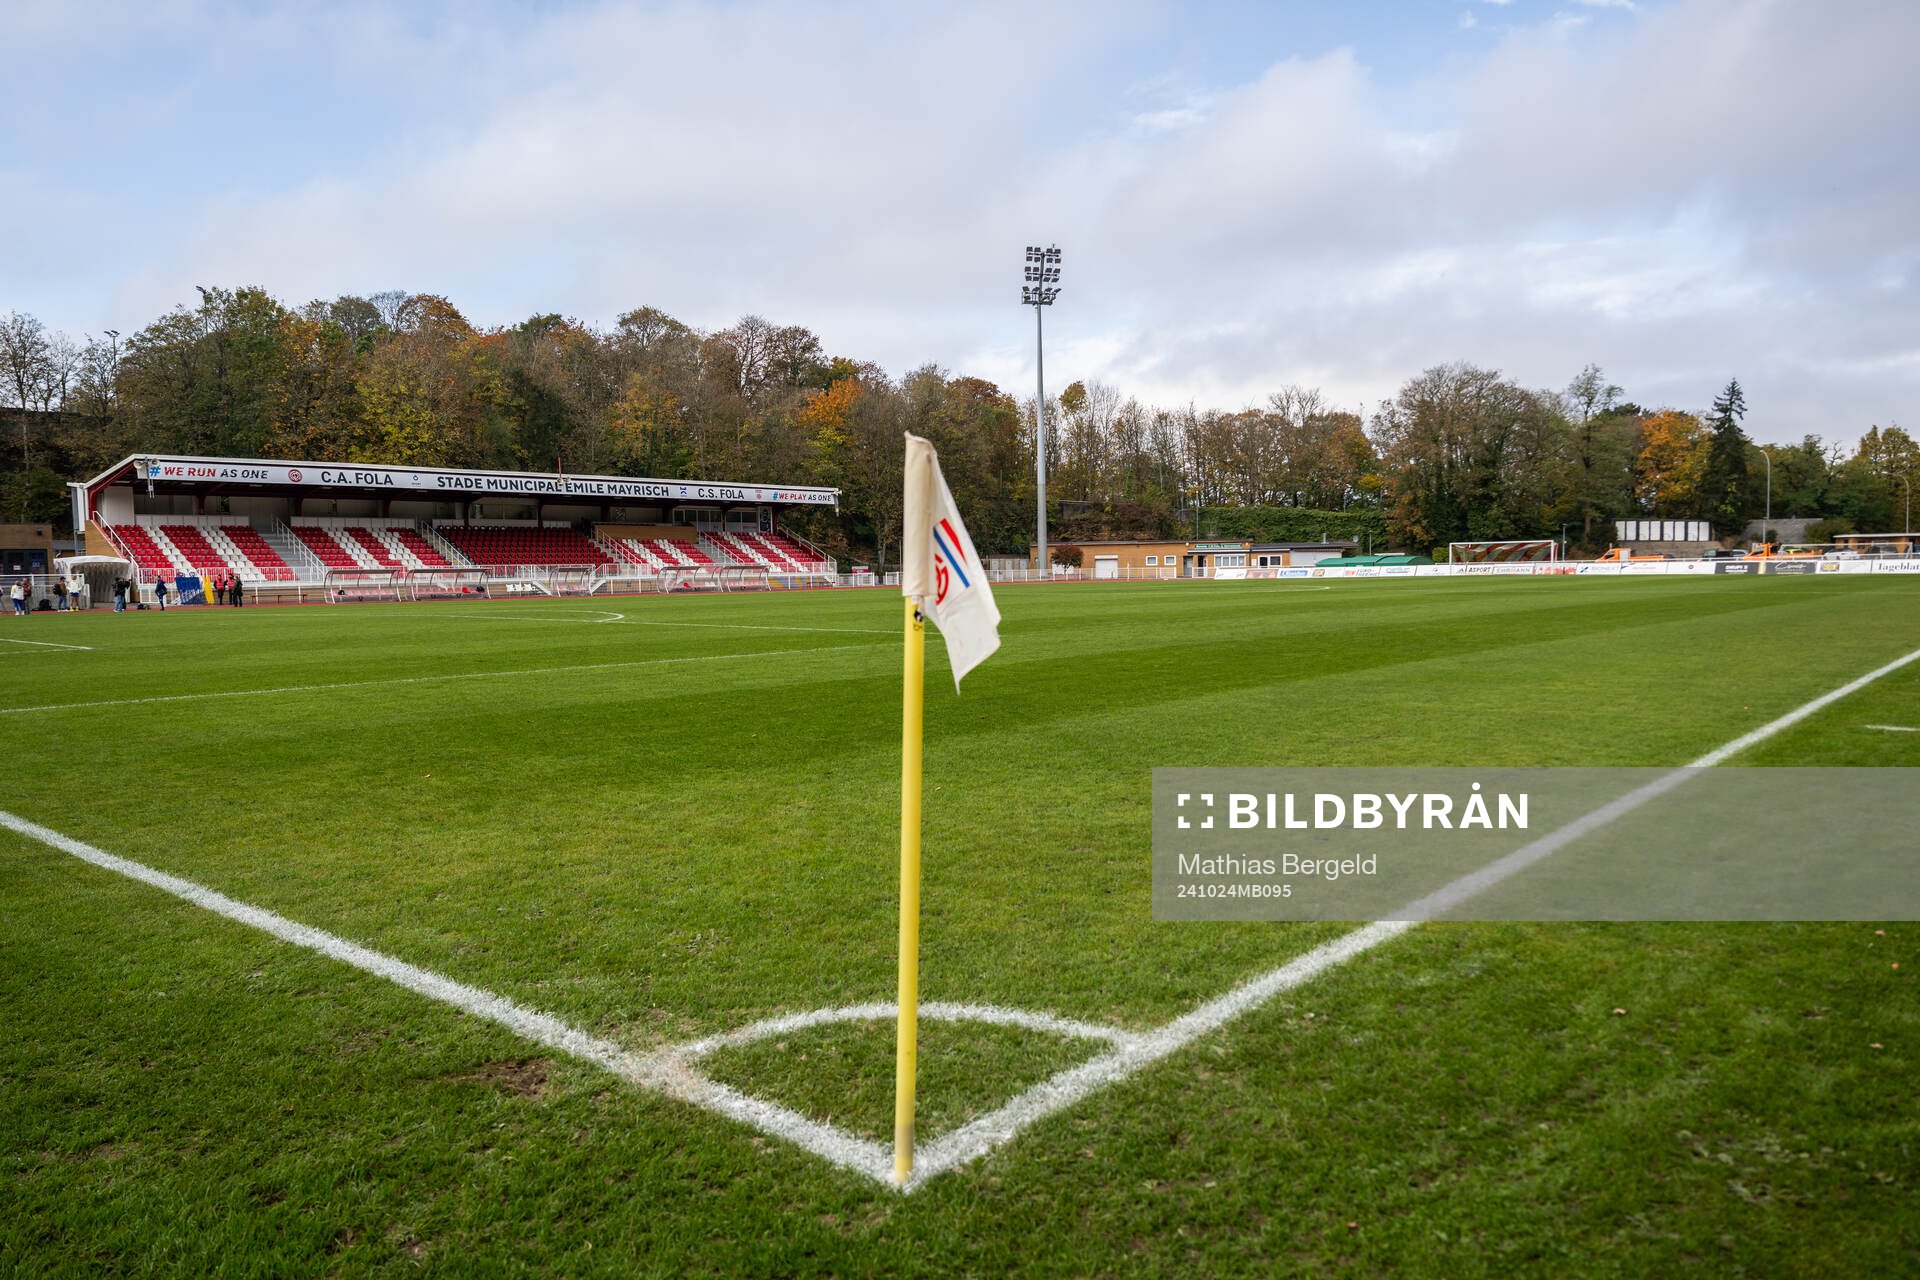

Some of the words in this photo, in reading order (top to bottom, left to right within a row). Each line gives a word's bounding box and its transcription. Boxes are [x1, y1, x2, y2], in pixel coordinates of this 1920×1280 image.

[187, 468, 216, 478] RUN
[220, 469, 238, 478] AS
[241, 470, 269, 479] ONE
[355, 472, 394, 486] FOLA
[437, 476, 483, 489] STADE
[487, 479, 562, 493] MUNICIPAL
[607, 484, 670, 496] MAYRISCH
[720, 489, 745, 500] FOLA
[790, 493, 807, 501] PLAY
